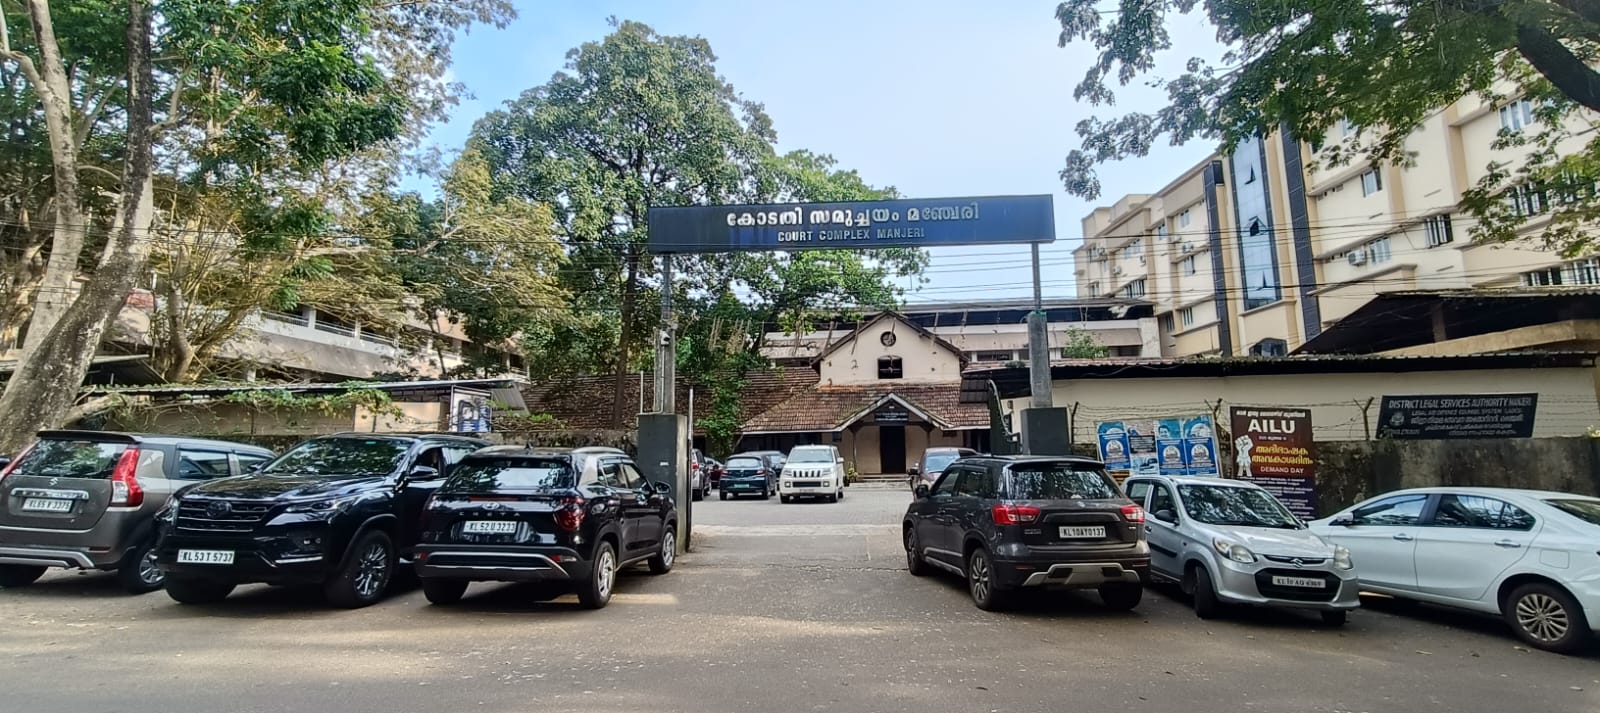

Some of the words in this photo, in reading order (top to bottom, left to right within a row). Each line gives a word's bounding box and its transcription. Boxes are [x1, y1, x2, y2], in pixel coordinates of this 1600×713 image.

[727, 207, 803, 226] കോടതി
[810, 209, 900, 227] സമുച്ചയം
[907, 202, 979, 221] മഞ്ചേരി
[777, 231, 813, 241] COURT
[819, 229, 870, 240] COMPLEX
[877, 228, 925, 239] MANJERI
[1389, 400, 1419, 408] DISTRICT
[1420, 399, 1439, 408] LEGAL
[1440, 399, 1471, 408] SERVICES
[1471, 398, 1508, 407] AUTHORITY
[1248, 419, 1295, 433] AILU
